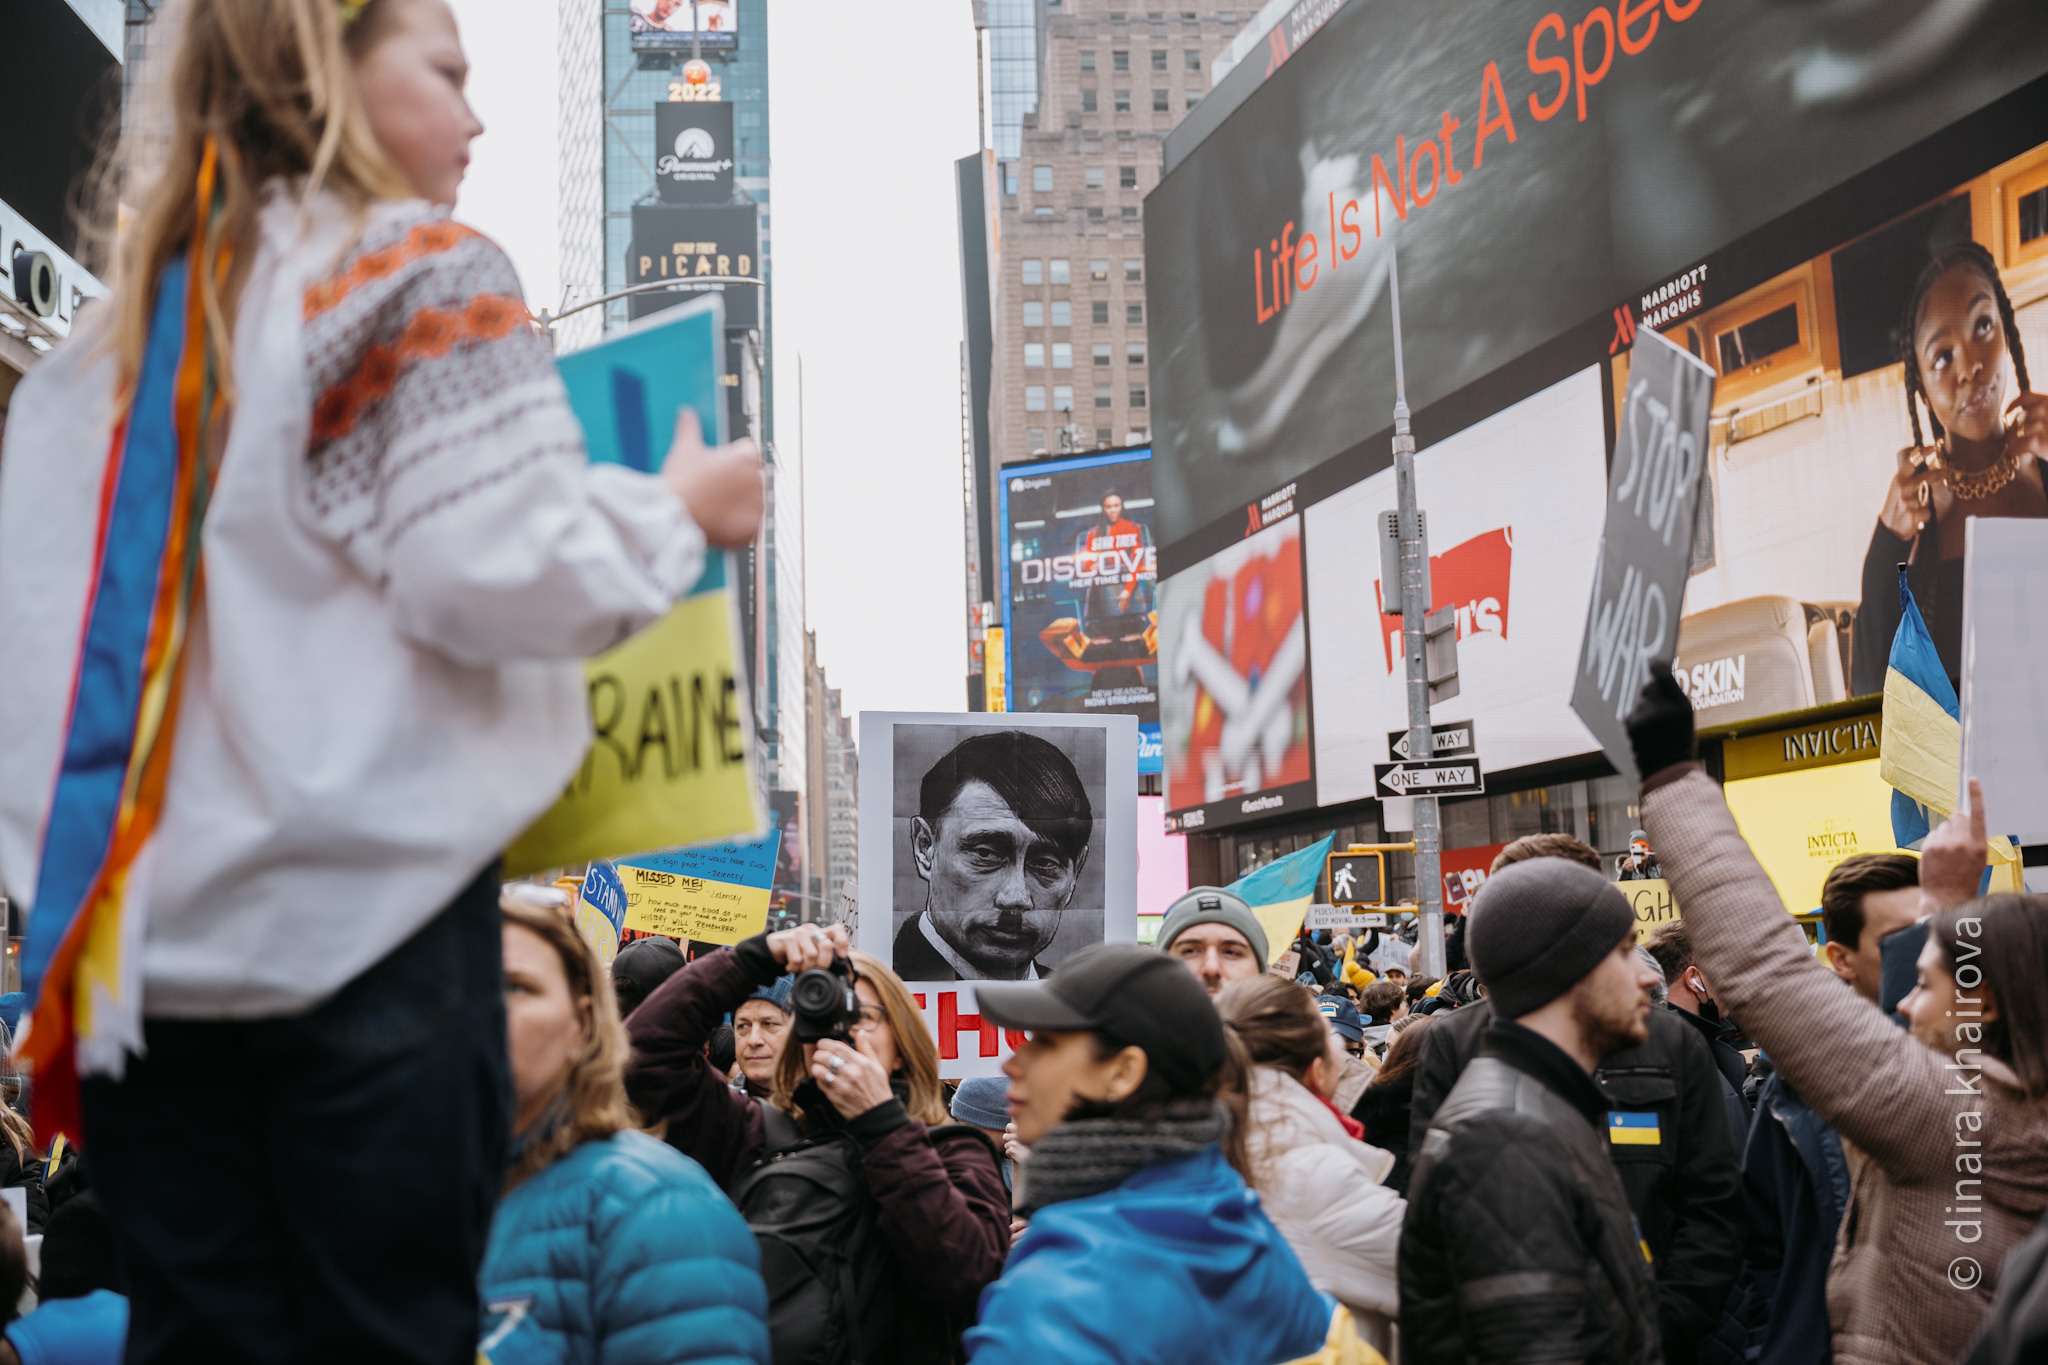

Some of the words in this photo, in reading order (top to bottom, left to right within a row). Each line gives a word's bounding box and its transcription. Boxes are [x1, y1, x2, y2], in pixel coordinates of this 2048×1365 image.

[668, 83, 721, 102] 2022
[1254, 220, 1319, 325] Life
[1329, 190, 1362, 270] Is
[1371, 110, 1464, 238] Not
[1473, 60, 1518, 170] A
[639, 254, 752, 276] PICARD
[1641, 264, 1708, 312] MARRIOTT
[1642, 289, 1702, 329] MARQUIS
[1616, 378, 1697, 546] STOP
[1262, 482, 1297, 511] MARRIOTT
[1262, 499, 1294, 525] MARQUIS
[1091, 535, 1115, 551] STAR
[1115, 533, 1138, 548] TREK
[1585, 536, 1667, 722] WAR
[1690, 654, 1745, 698] SKIN
[1084, 697, 1106, 708] NOW
[1107, 692, 1156, 706] STREAMING
[1092, 688, 1112, 698] NEW
[1112, 686, 1148, 696] SEASON
[566, 670, 744, 799] RAINE
[1436, 732, 1463, 748] WAY
[1783, 720, 1879, 762] INVICTA
[1391, 772, 1421, 787] ONE
[1435, 769, 1466, 784] WAY
[1807, 831, 1858, 849] INVICTA
[648, 896, 662, 906] how
[702, 906, 720, 915] blood
[1314, 906, 1349, 916] PEDESTRIAN
[1624, 890, 1673, 922] GH
[640, 914, 667, 924] HISTORY
